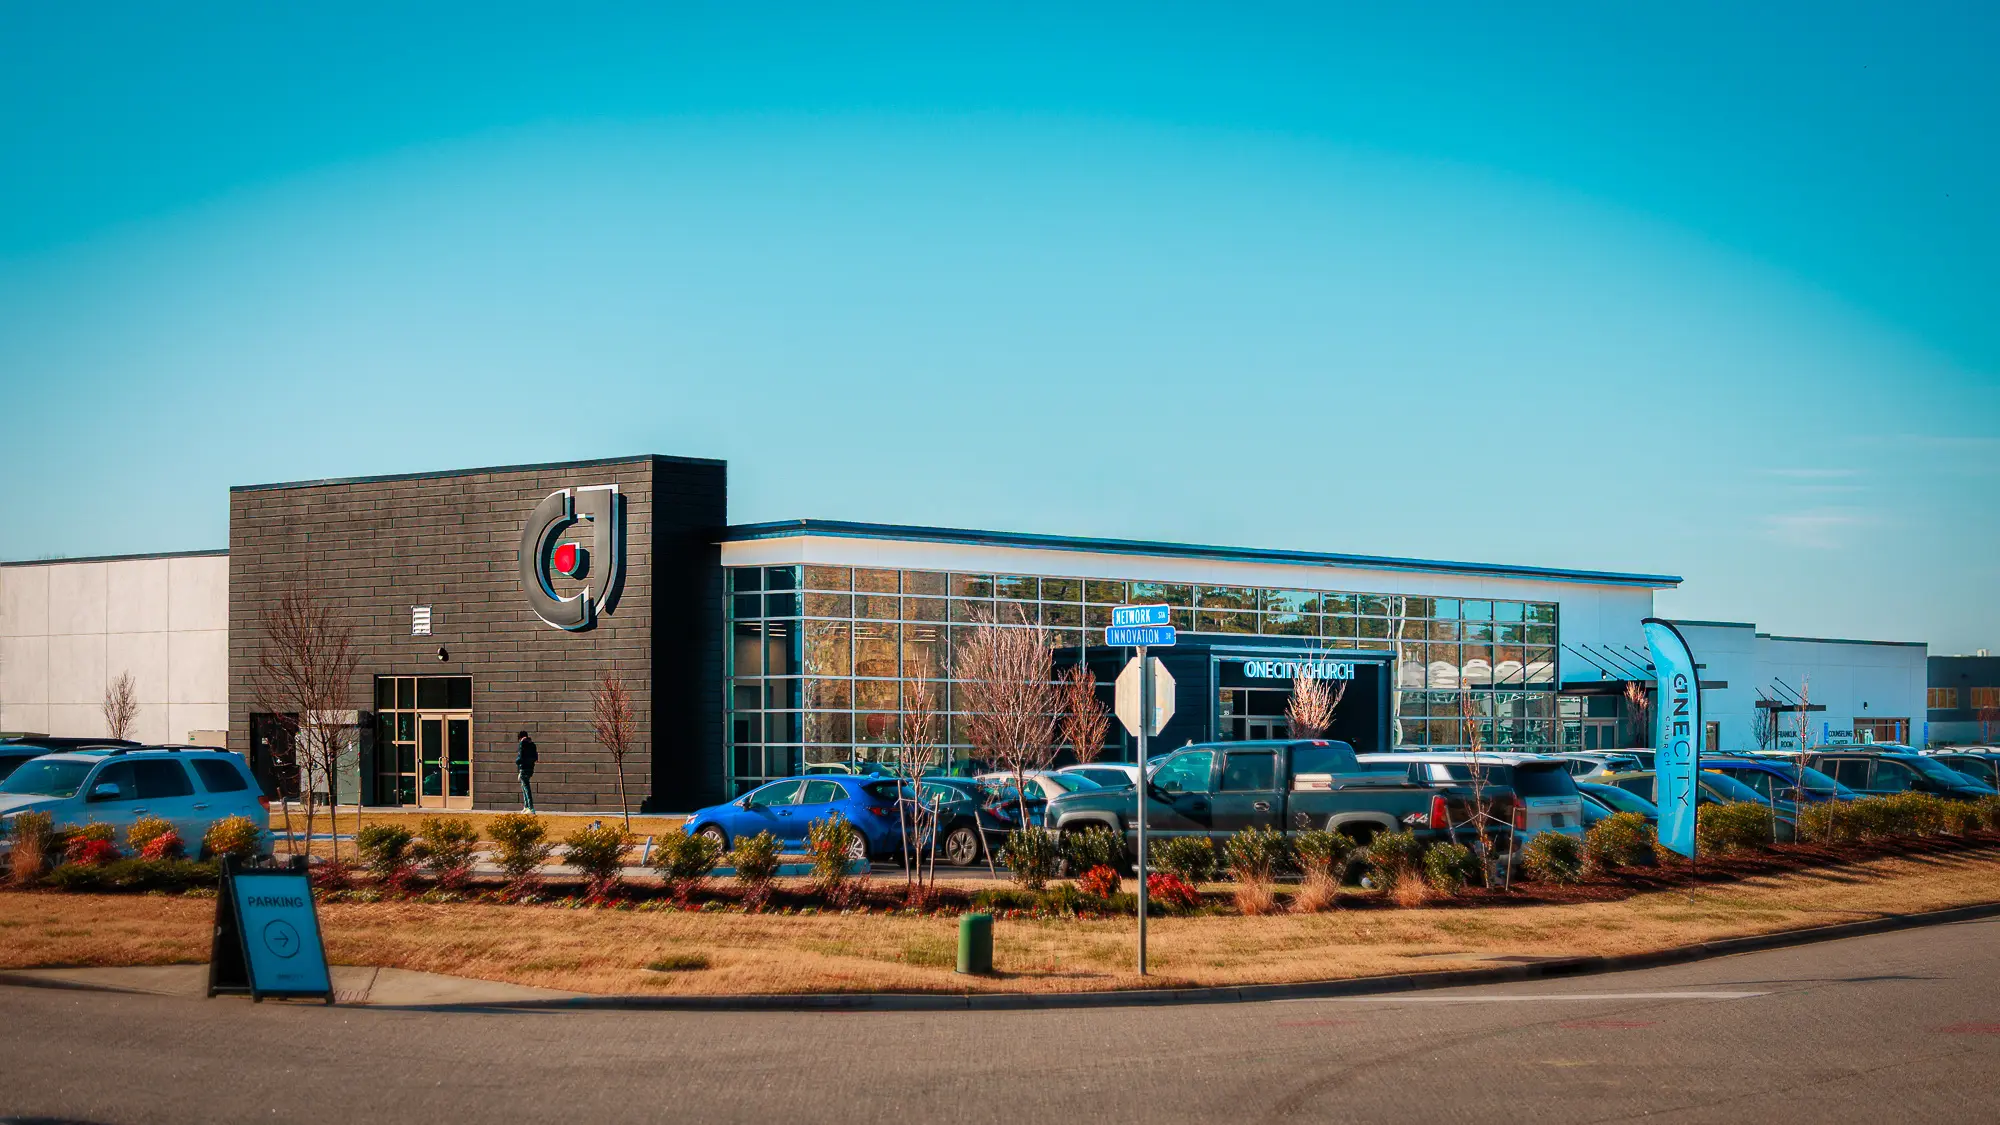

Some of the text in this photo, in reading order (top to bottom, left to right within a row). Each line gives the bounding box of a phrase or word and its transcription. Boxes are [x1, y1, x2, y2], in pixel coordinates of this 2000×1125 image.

[1116, 608, 1150, 625] NETWORK
[1111, 629, 1159, 643] INNOVATION
[1244, 661, 1355, 680] ONECITY CHURCH
[1663, 715, 1671, 766] CHURCH
[248, 896, 304, 908] PARKING
